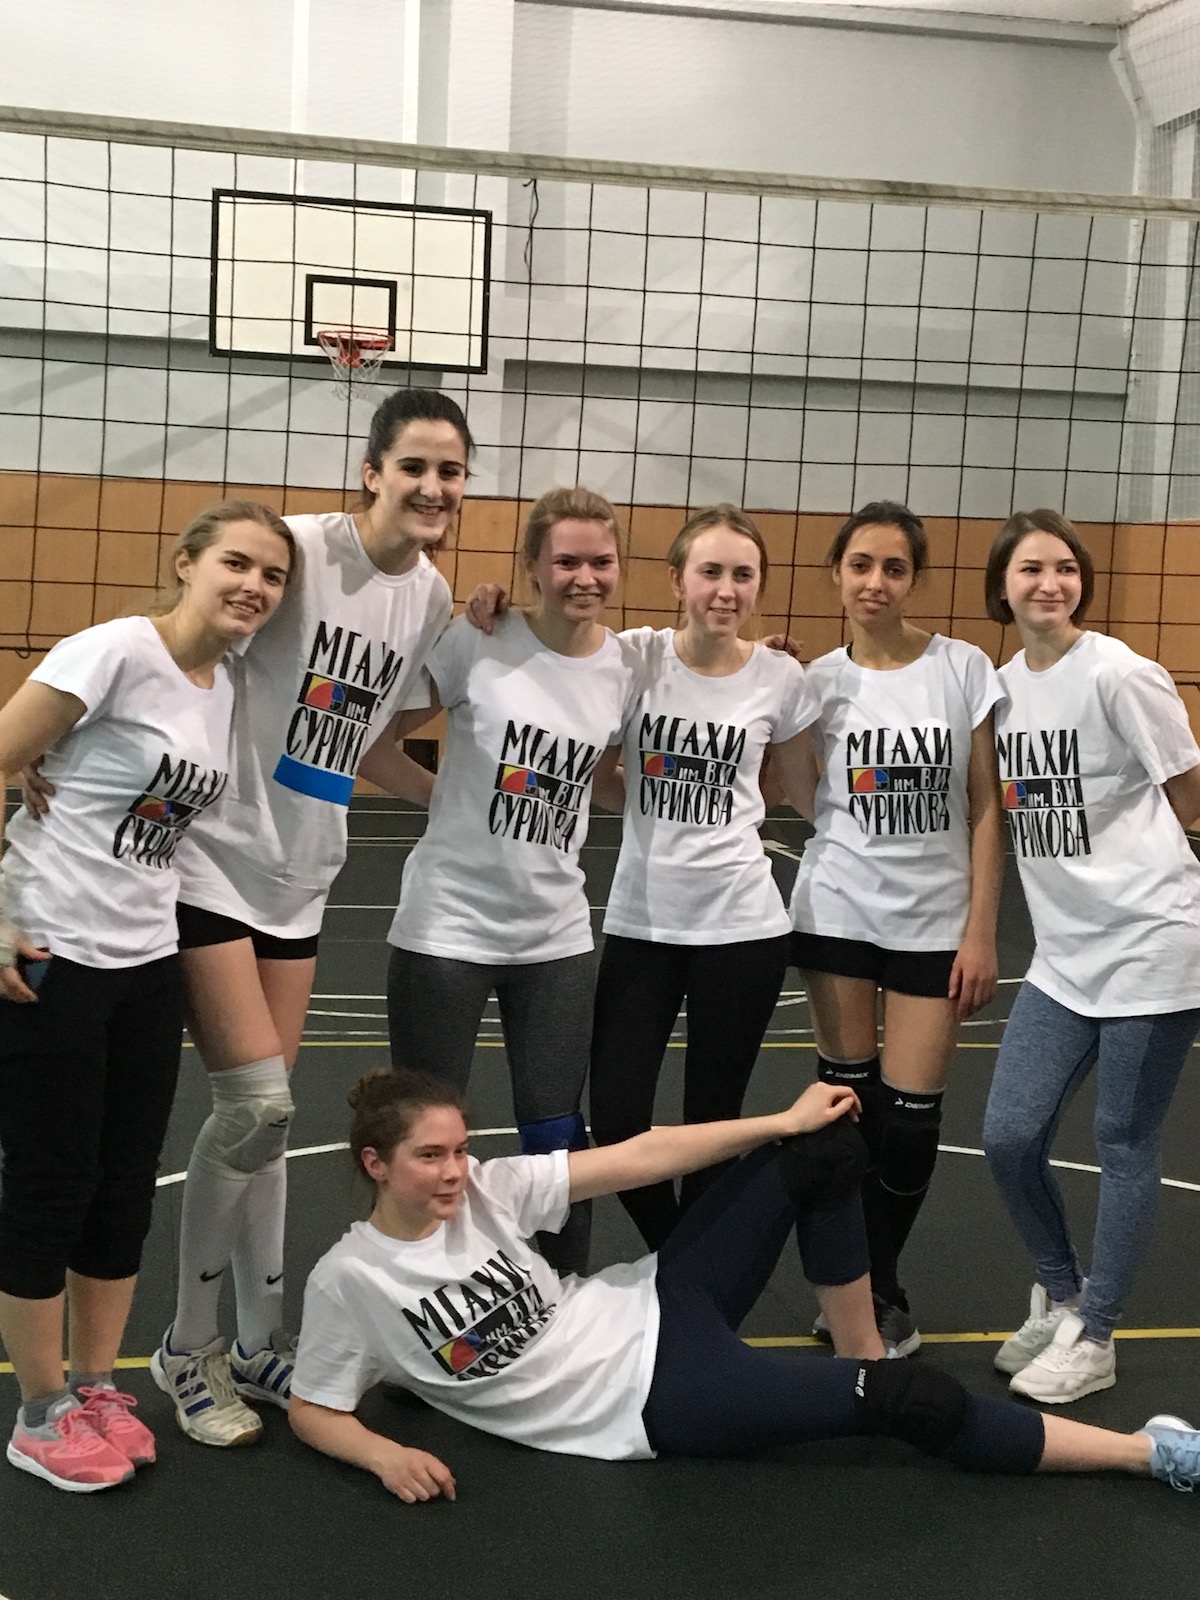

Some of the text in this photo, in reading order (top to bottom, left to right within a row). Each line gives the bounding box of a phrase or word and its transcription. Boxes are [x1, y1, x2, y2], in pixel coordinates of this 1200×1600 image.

[499, 719, 602, 785] МГАХИ
[639, 713, 747, 764] МГАХИ
[846, 727, 953, 767] МГАХИ
[639, 775, 734, 827] СУРИКОВА
[848, 792, 950, 836] СУРИКОВА
[401, 1249, 532, 1350] МГАХИ
